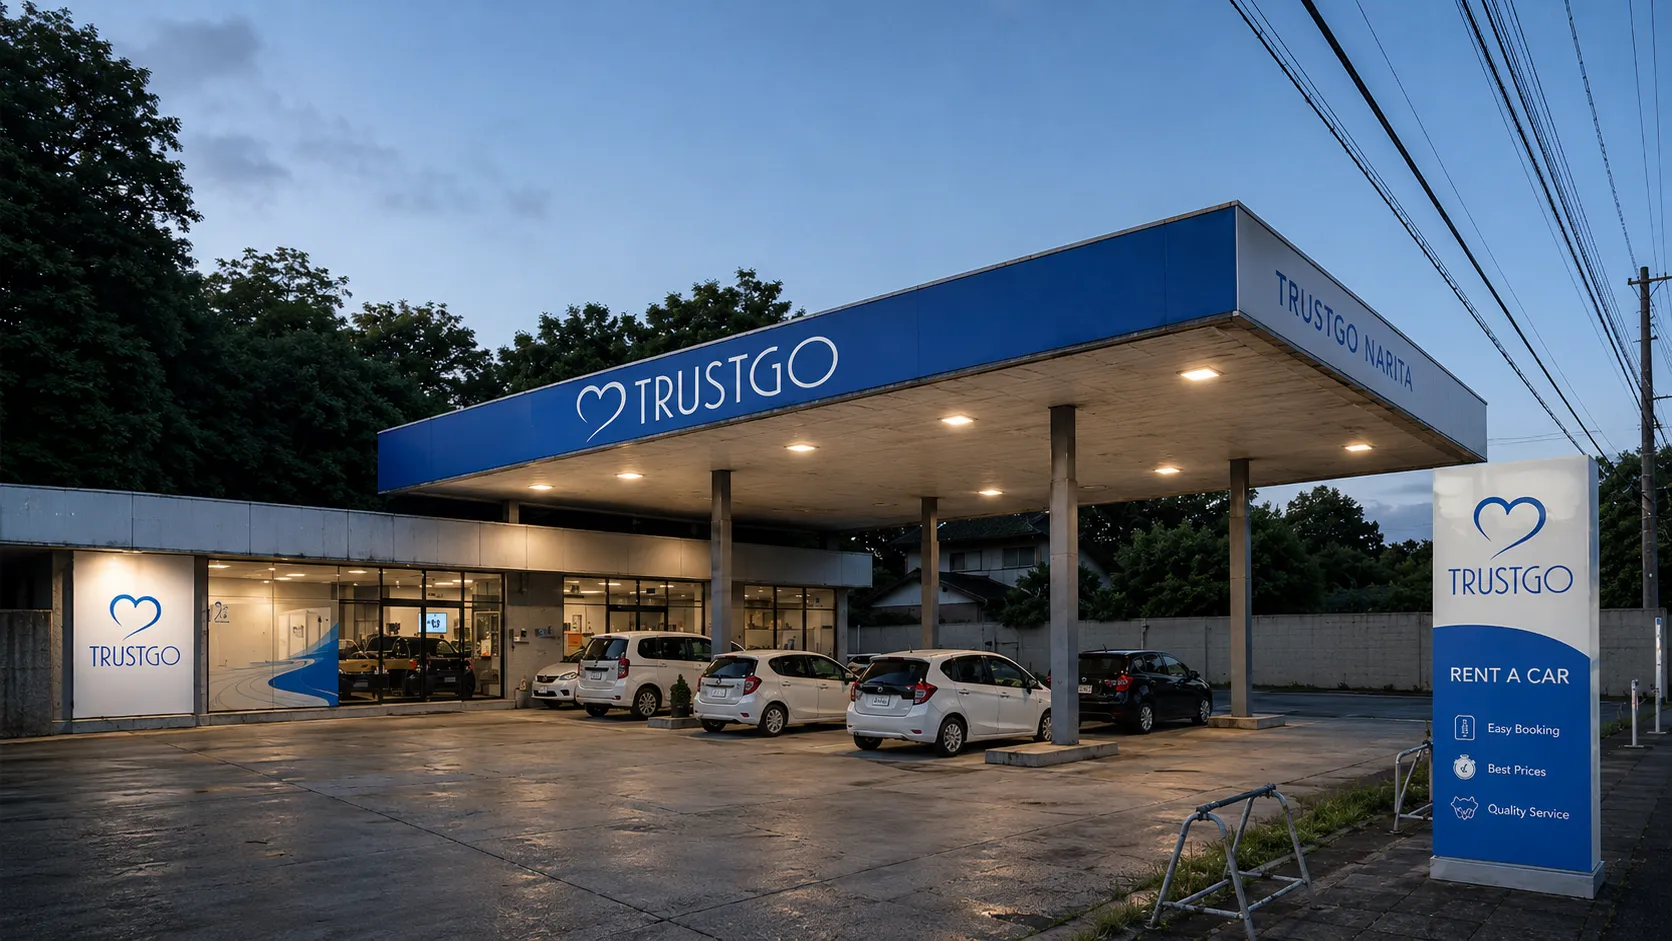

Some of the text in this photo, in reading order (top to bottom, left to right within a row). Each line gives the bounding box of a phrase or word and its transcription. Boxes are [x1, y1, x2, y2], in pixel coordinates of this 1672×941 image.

[1276, 270, 1413, 392] TRUSTGO NARITA
[635, 336, 838, 424] TRUSTGO
[1448, 565, 1573, 595] TRUSTGO
[89, 645, 180, 667] TRUSTGO
[1450, 667, 1569, 684] RENT A CAR
[1488, 723, 1560, 738] Easy Booking
[1488, 764, 1546, 777] Best Prices
[1488, 804, 1570, 820] Quality Service
